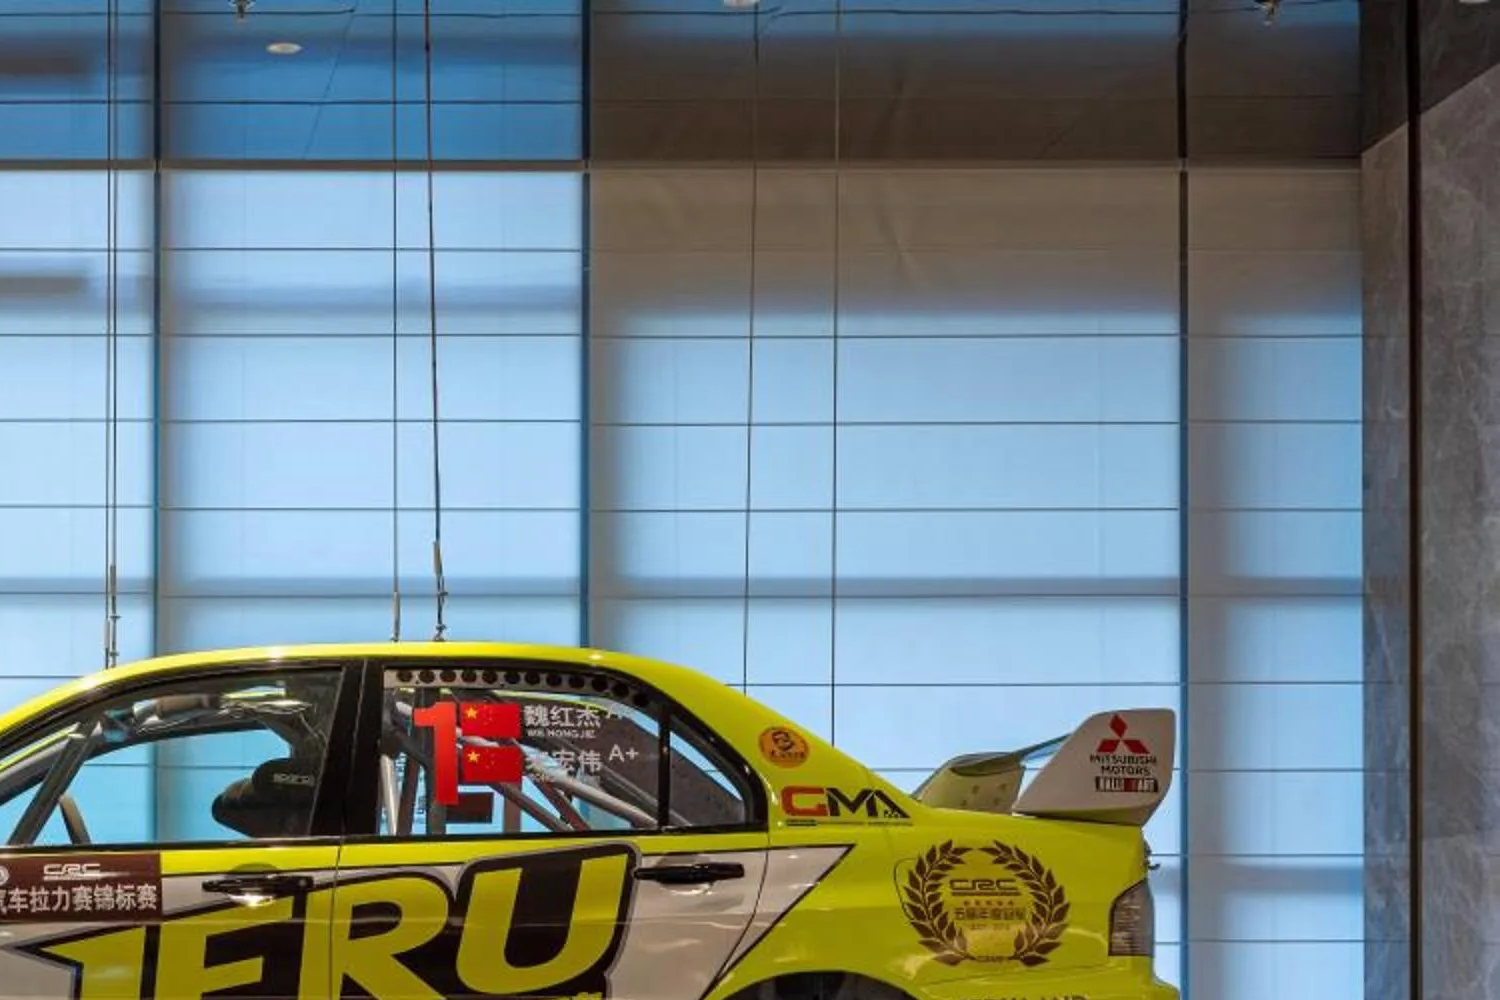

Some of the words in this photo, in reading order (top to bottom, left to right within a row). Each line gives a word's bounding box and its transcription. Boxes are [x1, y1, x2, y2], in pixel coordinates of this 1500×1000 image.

[524, 704, 601, 728] 魏红杰
[609, 743, 639, 763] A+
[1100, 765, 1151, 776] MOTORS
[950, 878, 1019, 891] CRC
